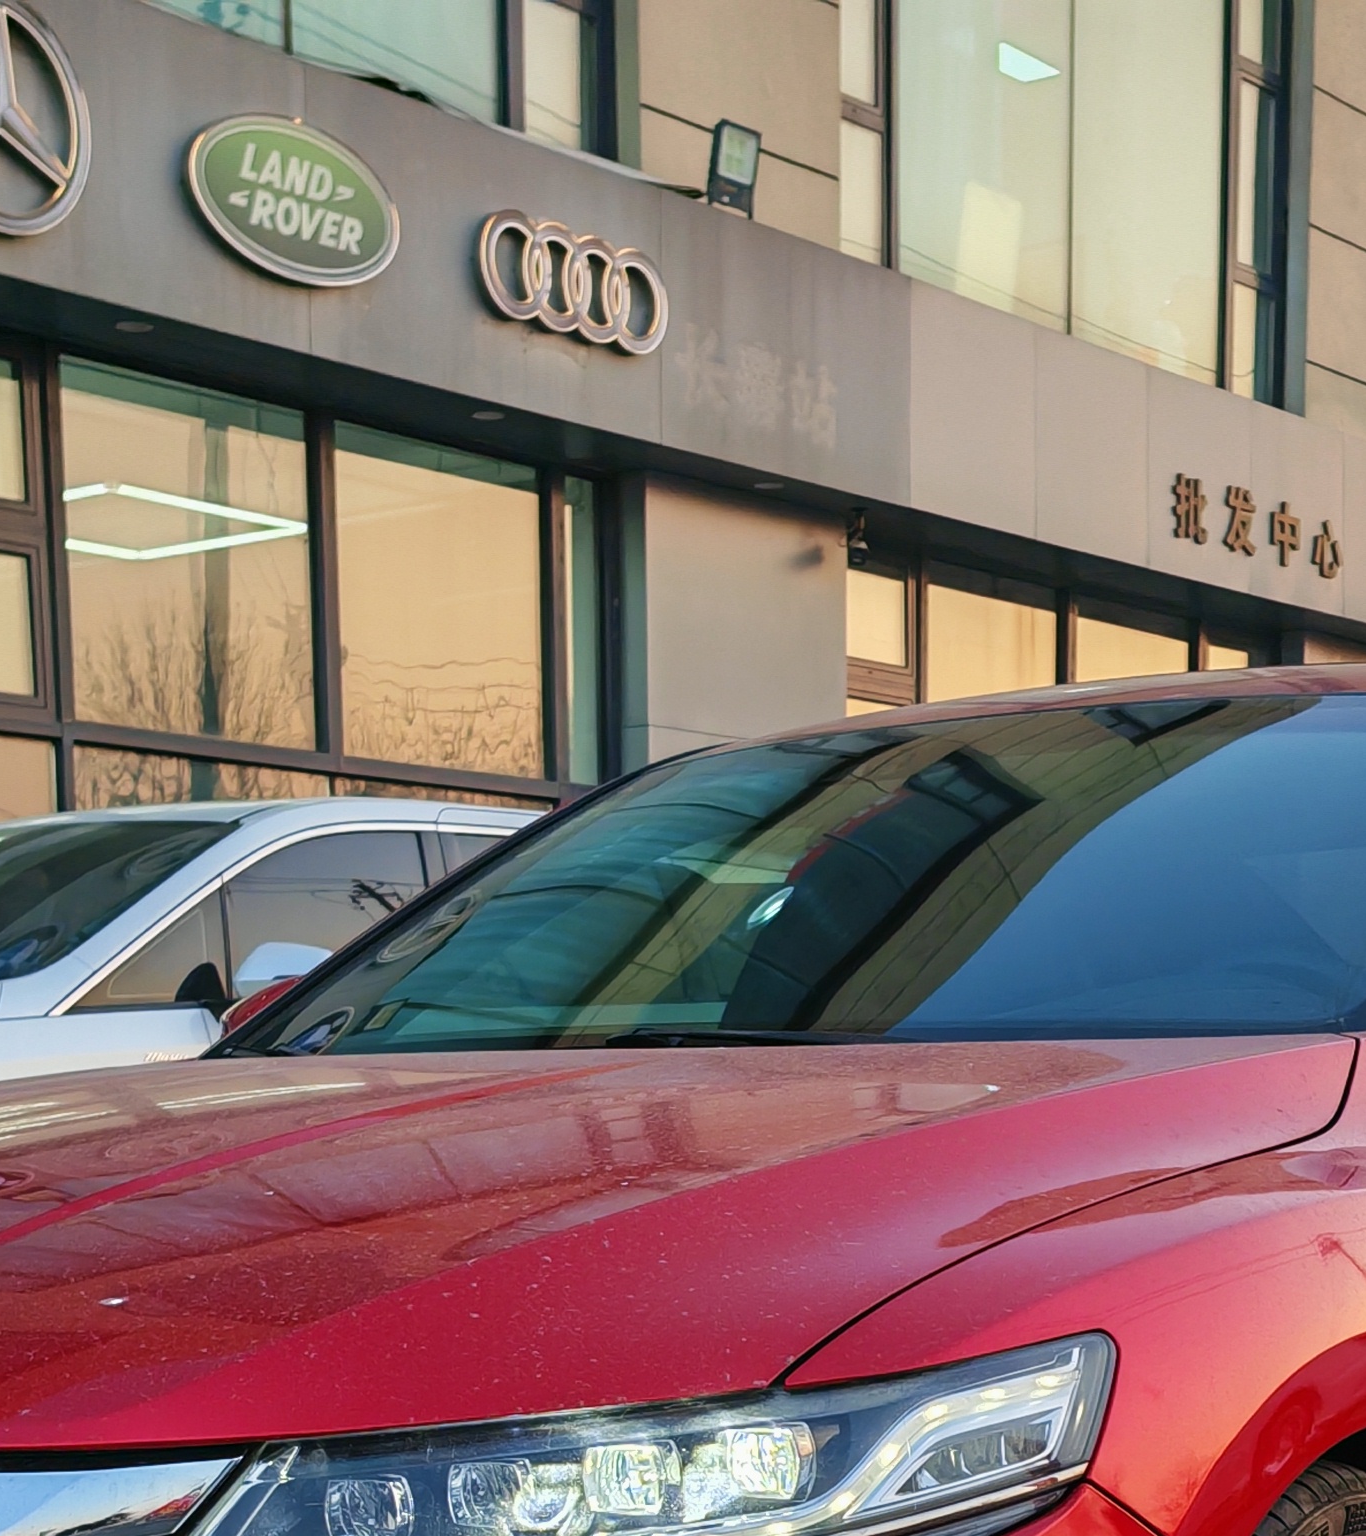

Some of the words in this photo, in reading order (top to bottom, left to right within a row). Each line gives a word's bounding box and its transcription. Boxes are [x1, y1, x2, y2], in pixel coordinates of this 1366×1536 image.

[238, 141, 334, 202] LAND
[249, 189, 365, 256] ROVER
[1170, 472, 1344, 580] 批发中心
